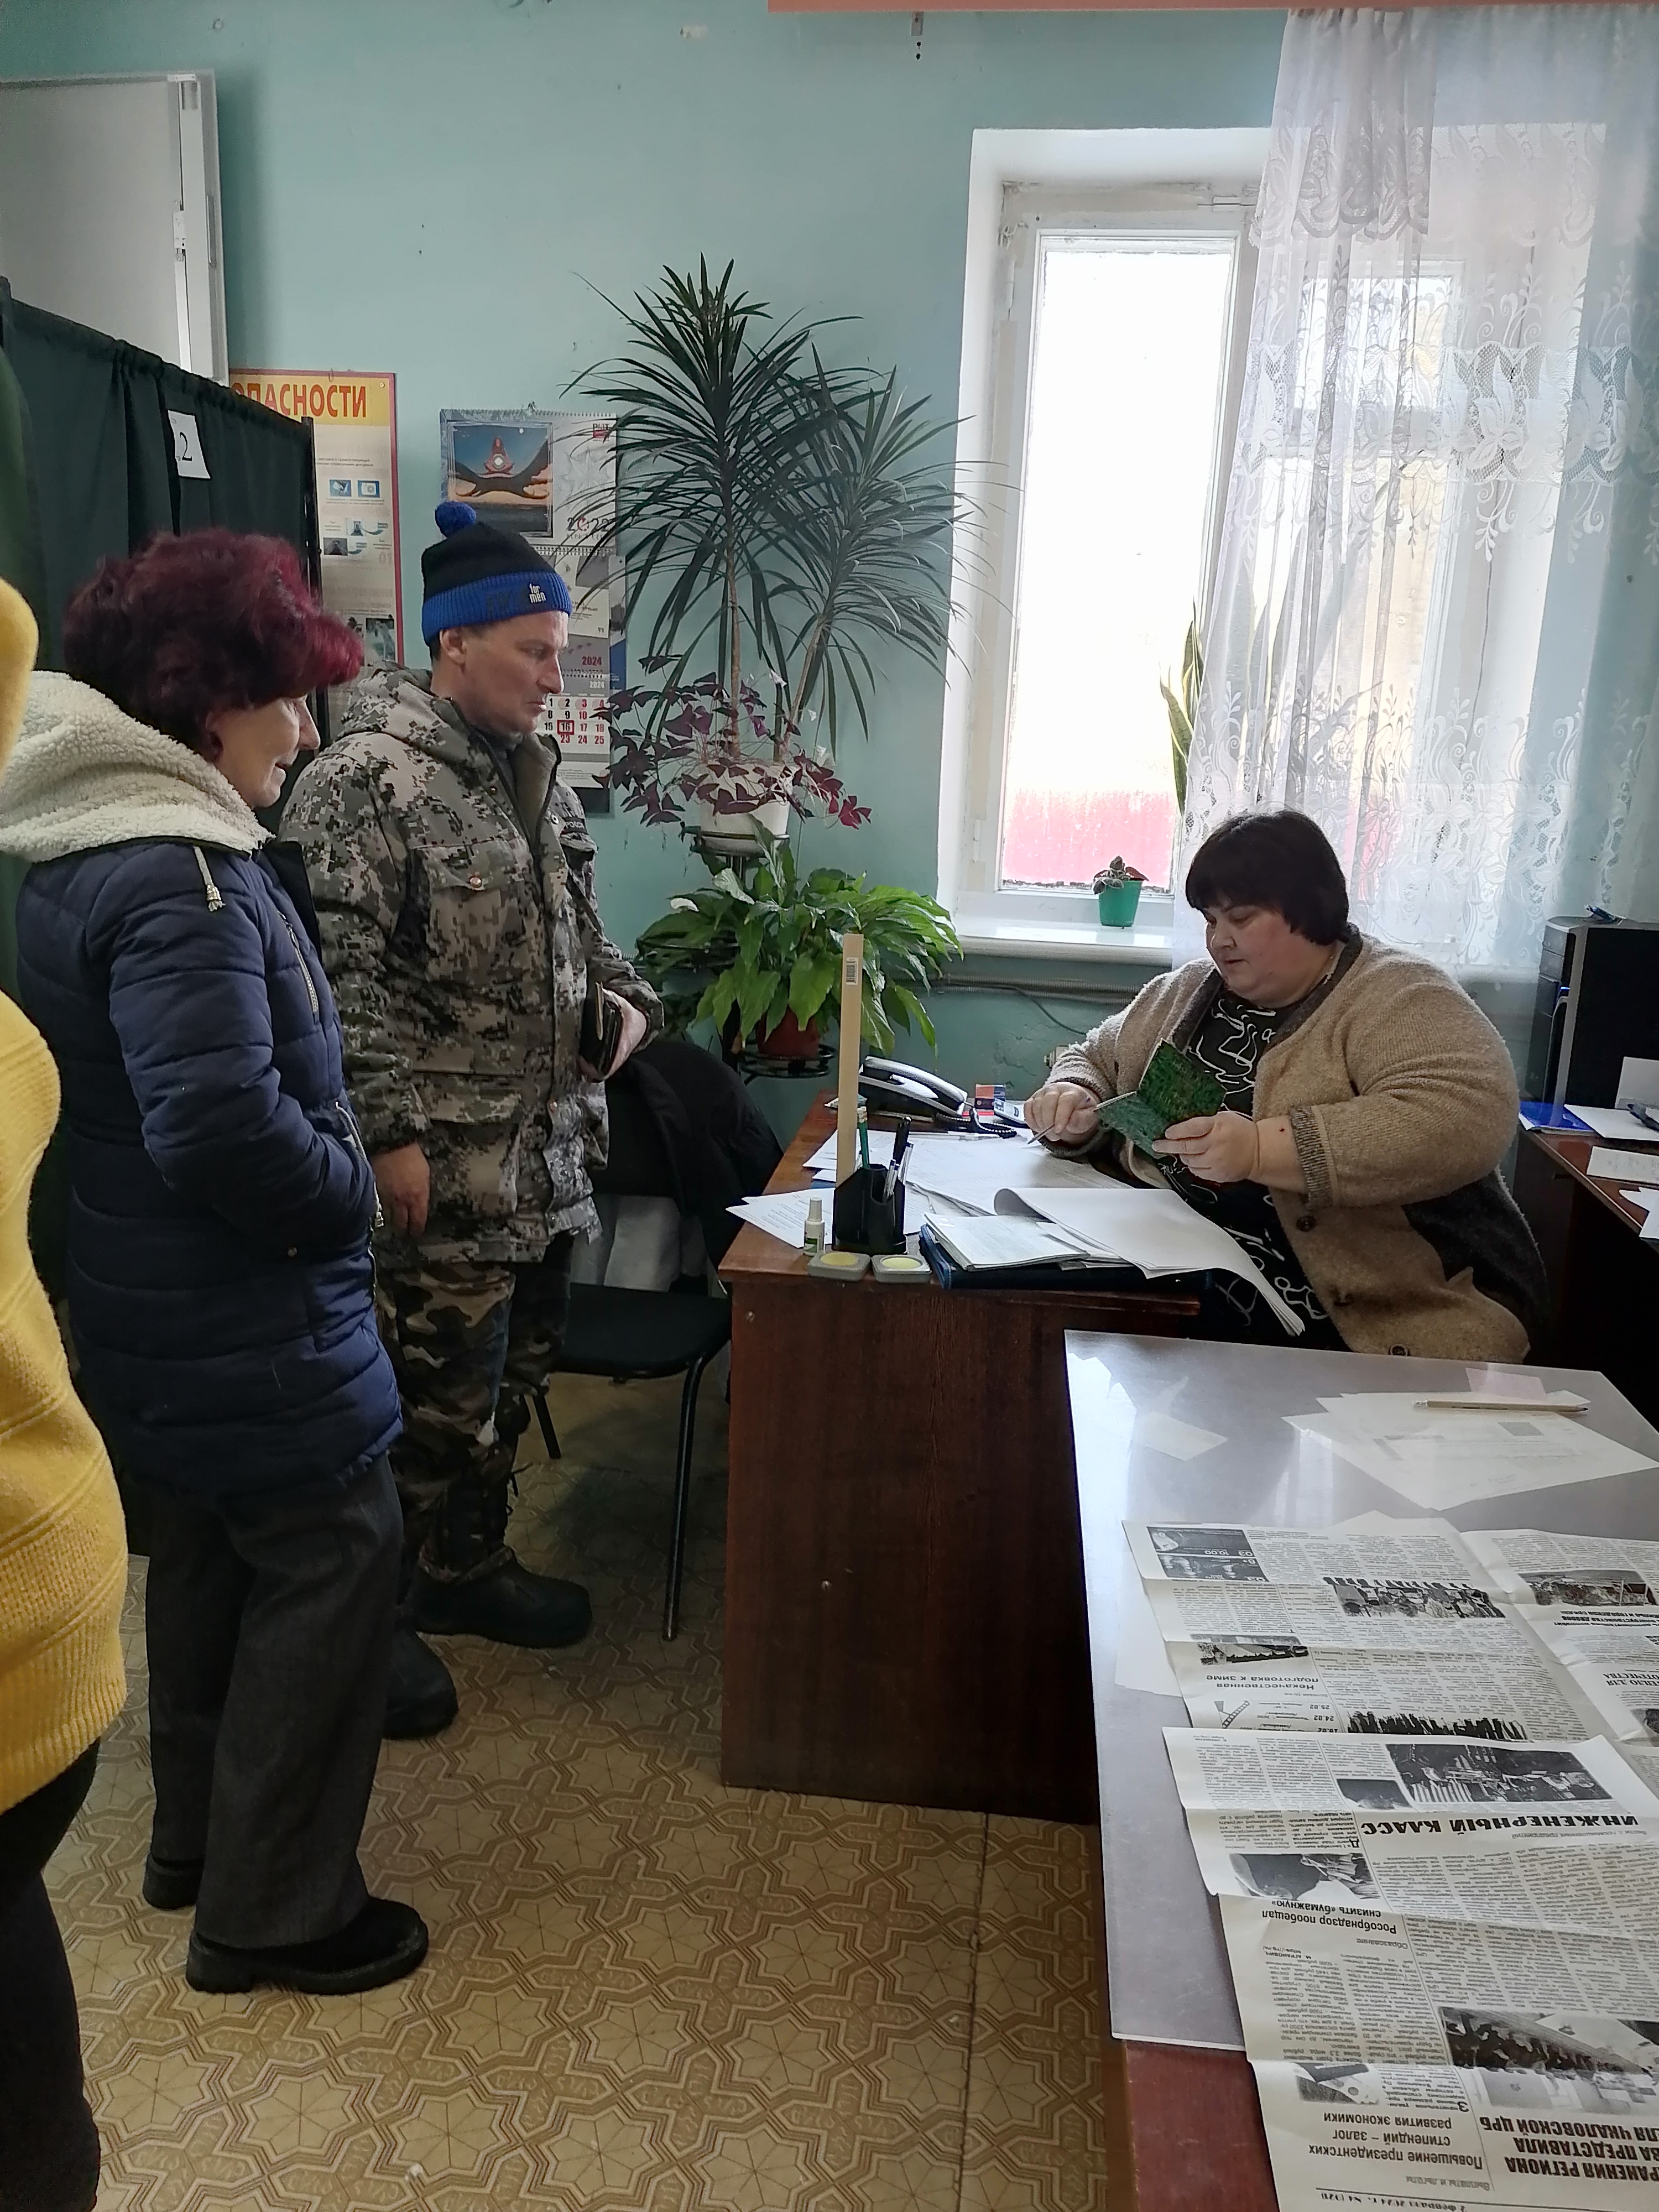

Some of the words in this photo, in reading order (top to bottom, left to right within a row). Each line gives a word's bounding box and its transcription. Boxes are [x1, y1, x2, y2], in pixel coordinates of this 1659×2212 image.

[180, 432, 192, 461] 2
[529, 583, 540, 594] for
[529, 592, 546, 603] men
[582, 656, 602, 666] 2024
[549, 698, 553, 707] 1
[565, 698, 570, 707] 2
[582, 699, 587, 708] 3
[565, 711, 570, 719] 9
[579, 711, 587, 719] 10
[544, 722, 553, 731] 15
[581, 723, 587, 732] 17
[596, 724, 604, 732] 18
[560, 734, 570, 743] 23
[578, 735, 587, 744] 24
[594, 735, 604, 744] 25
[1361, 1820, 1442, 1835] КЛАСС
[1449, 1815, 1639, 1835] ИНЖЕНЕРНЫЙ
[1271, 1900, 1335, 1915] «бумажную»
[1339, 1906, 1381, 1918] снизить
[1261, 1910, 1316, 1923] пообещал
[1319, 1915, 1397, 1934] Рособрнадзор
[1356, 1938, 1408, 1949] Образование
[1324, 2112, 1391, 2125] экономики
[1395, 2117, 1452, 2129] развития
[1479, 2116, 1515, 2132] ЦРБ
[1332, 2130, 1367, 2141] залог
[1516, 2119, 1632, 2140] ЧКАЛОВСКОЙ
[1633, 2127, 1659, 2142] ЛЯ
[1383, 2131, 1451, 2146] стипендий
[1308, 2145, 1404, 2161] президентских
[1512, 2137, 1638, 2161] ПРЕДСТАВИЛА
[1407, 2152, 1483, 2170] Повышение
[1504, 2157, 1580, 2177] РЕГИОНА
[1582, 2162, 1659, 2182] РАНЕНИЯ
